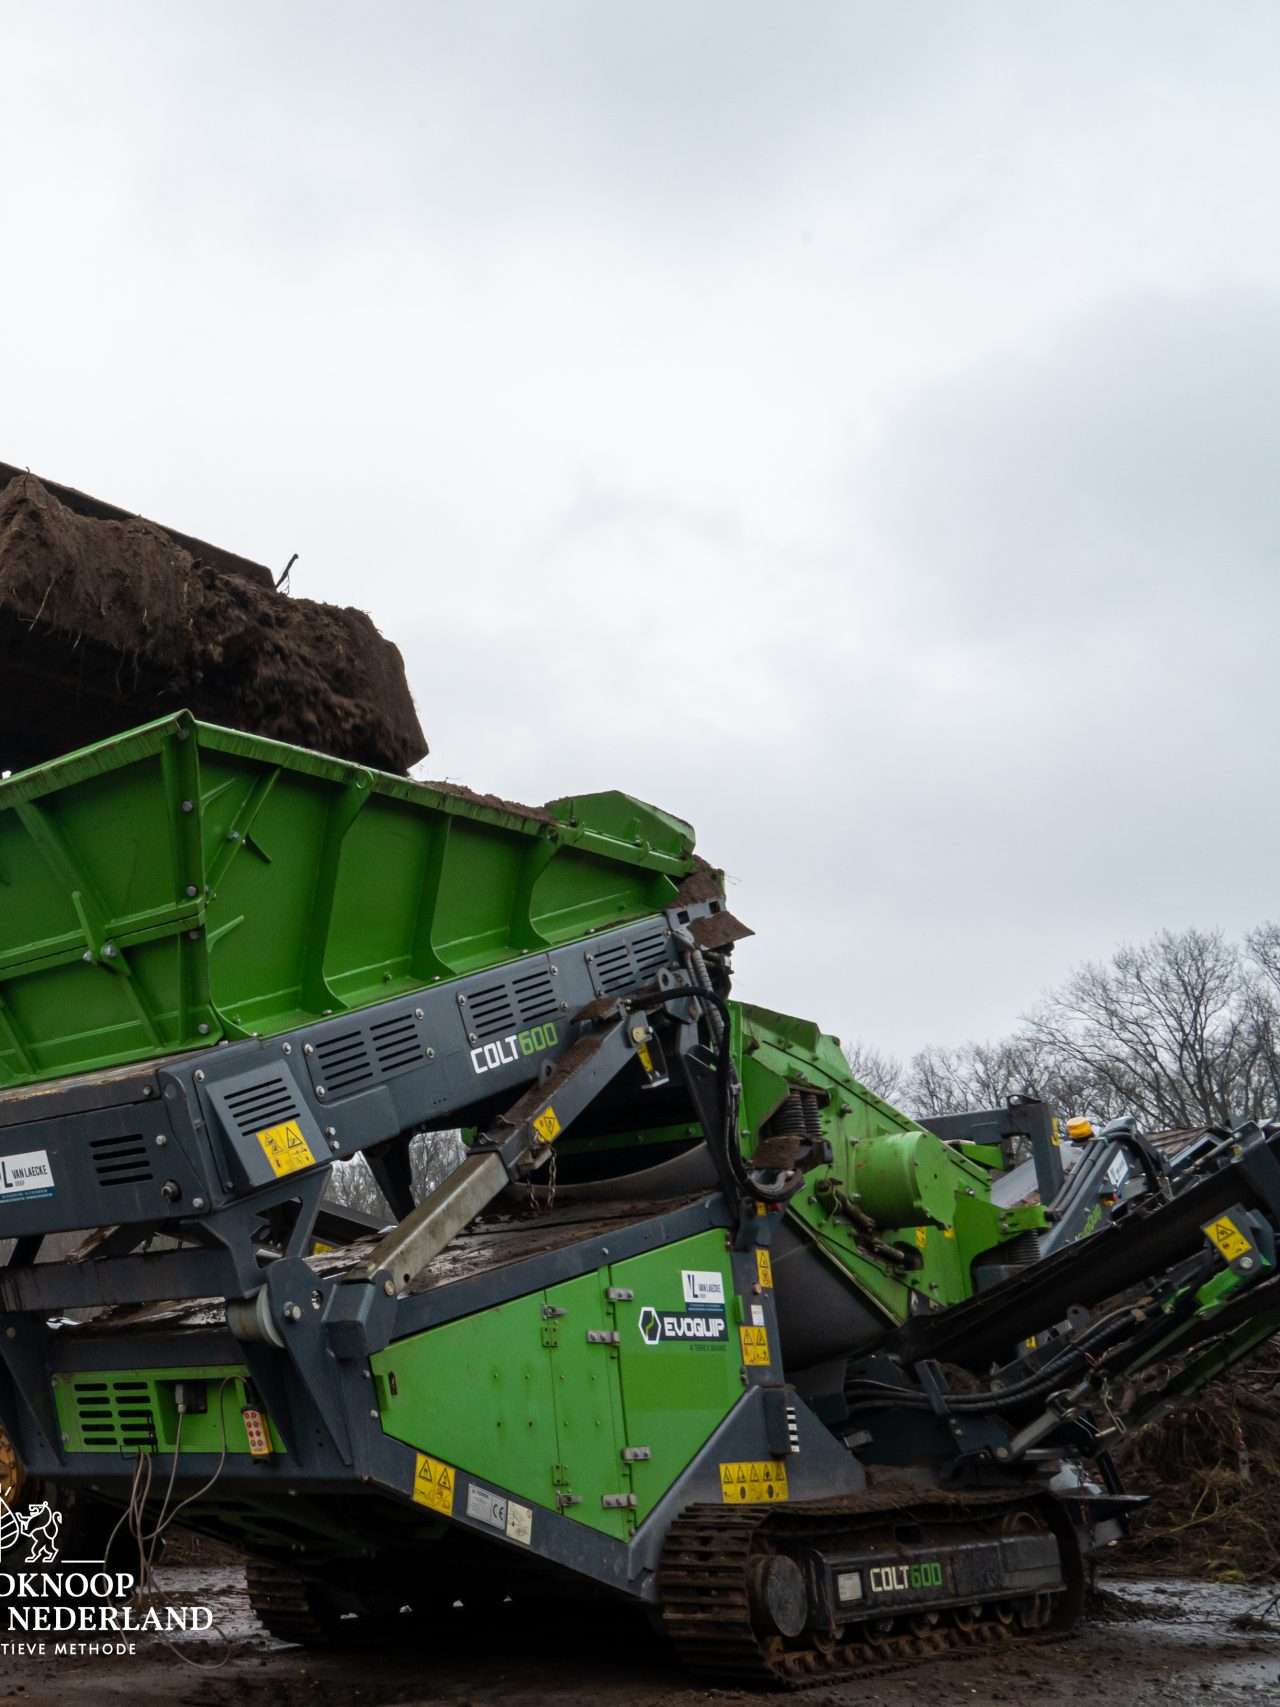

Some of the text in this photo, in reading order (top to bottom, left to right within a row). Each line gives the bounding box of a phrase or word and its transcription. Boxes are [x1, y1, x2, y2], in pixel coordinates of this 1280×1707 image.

[470, 1022, 559, 1074] COLT600
[11, 1165, 48, 1180] VAN LAECKE
[663, 1317, 725, 1337] EVOQUIP
